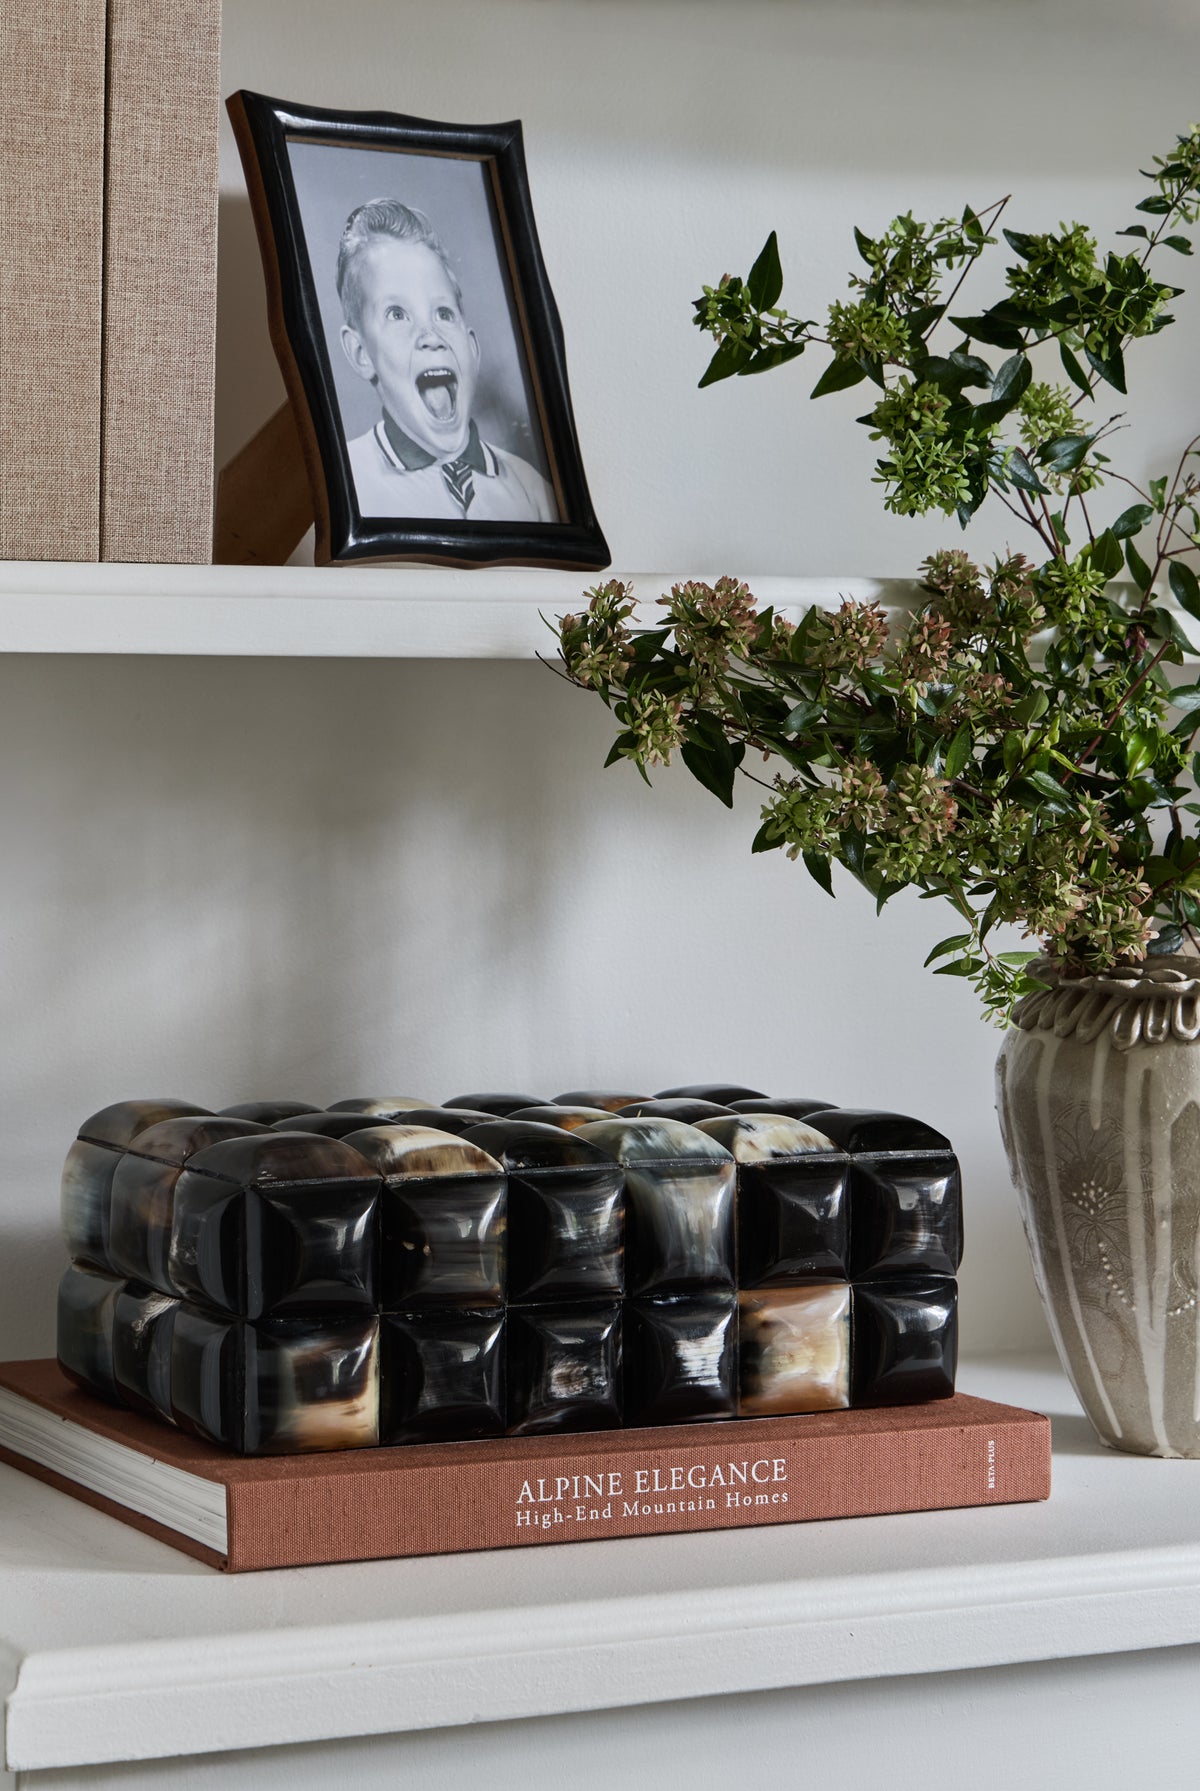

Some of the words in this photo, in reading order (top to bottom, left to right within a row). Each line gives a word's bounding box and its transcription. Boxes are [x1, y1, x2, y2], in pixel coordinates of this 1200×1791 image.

[515, 1472, 624, 1504] ALPINE
[633, 1458, 788, 1494] ELEGANCE
[515, 1502, 613, 1530] High-End
[622, 1494, 716, 1517] Mountain
[725, 1491, 789, 1508] Homes
